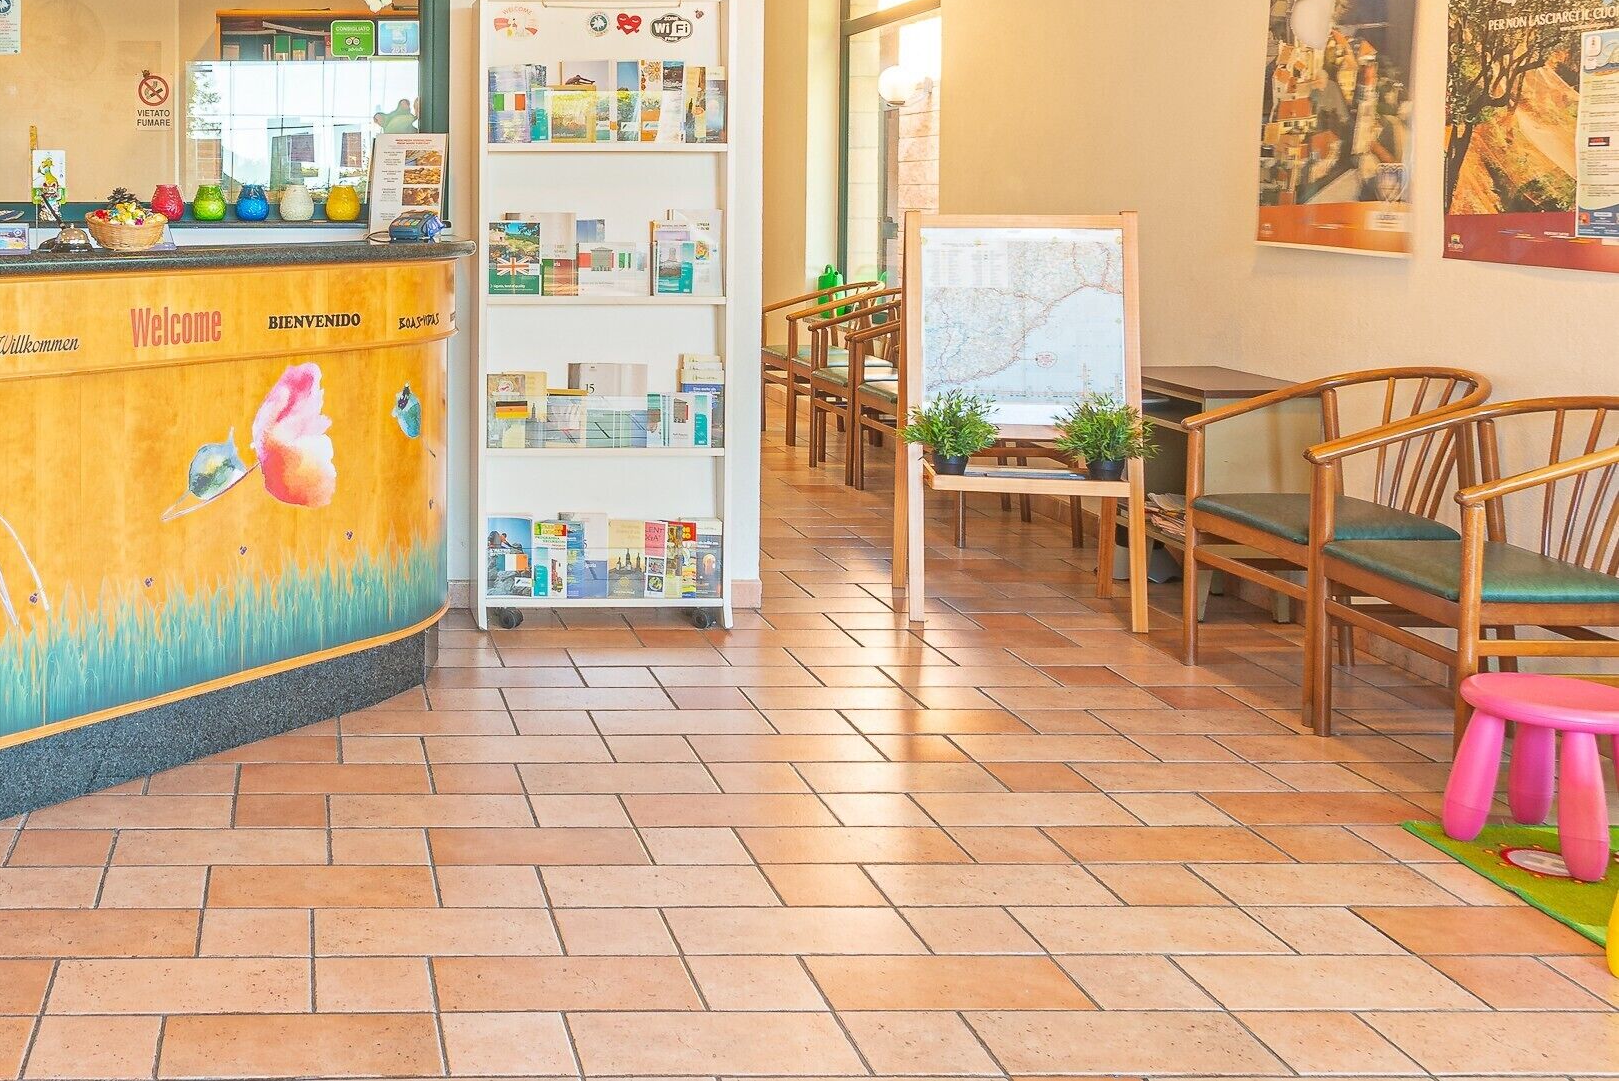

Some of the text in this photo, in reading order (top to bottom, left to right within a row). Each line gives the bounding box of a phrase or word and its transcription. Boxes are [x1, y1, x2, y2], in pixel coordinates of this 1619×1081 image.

[1488, 19, 1506, 31] PER
[1506, 16, 1528, 28] NON
[1529, 10, 1579, 26] LASCIARCI
[137, 109, 170, 117] VIETATO
[137, 118, 170, 126] FUMARE
[130, 306, 222, 348] Welcome
[268, 313, 361, 330] BIENVENIDO
